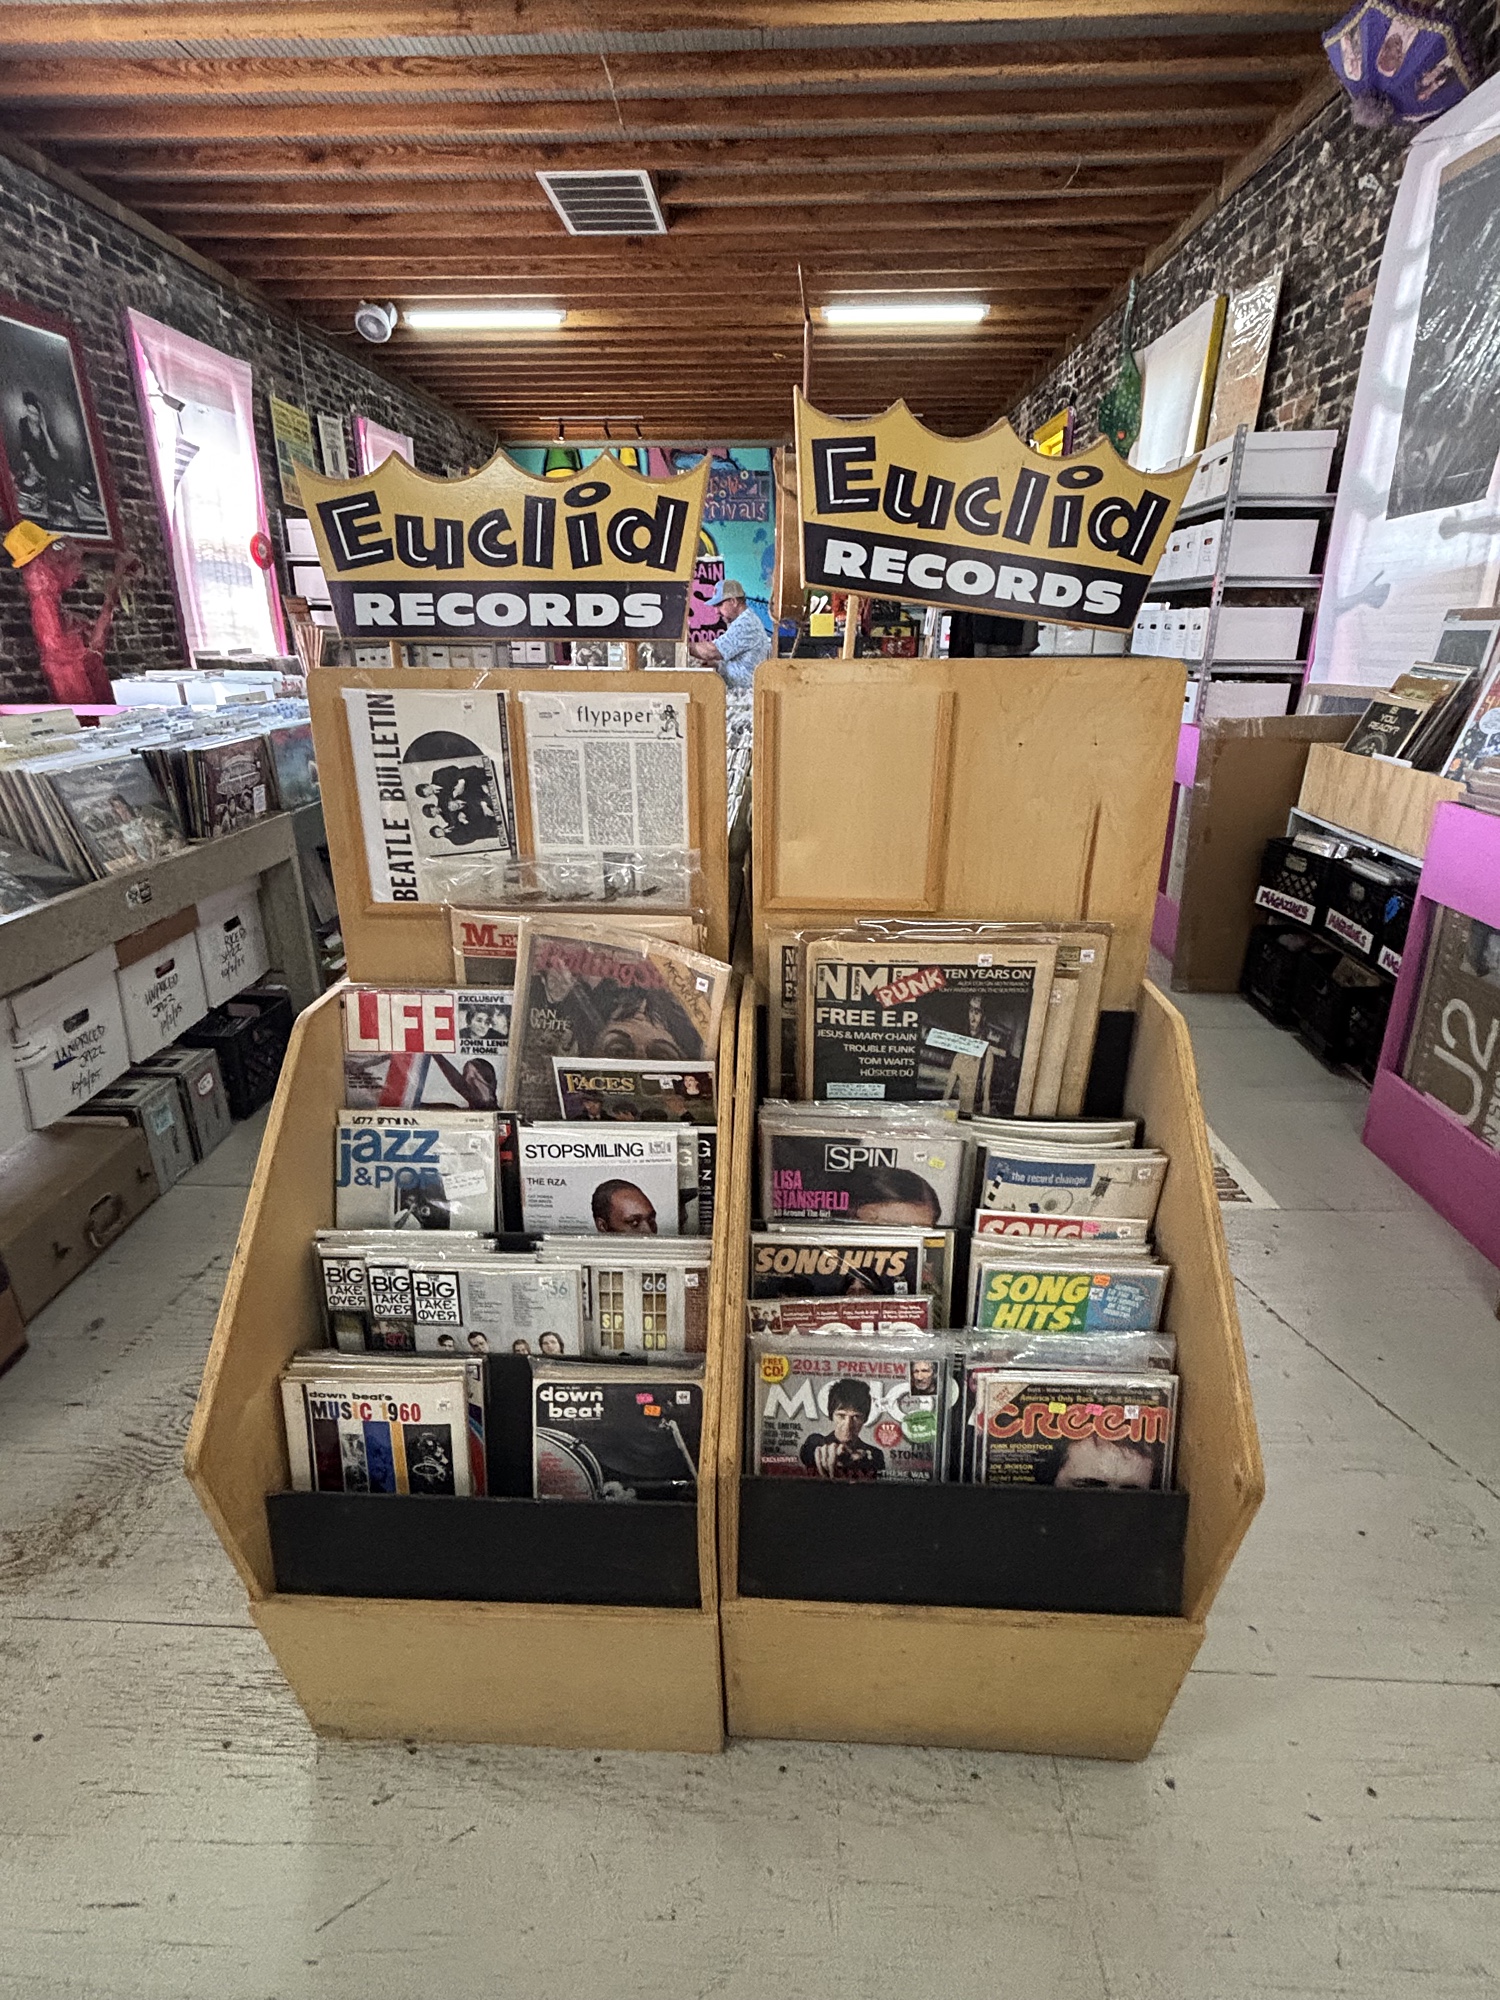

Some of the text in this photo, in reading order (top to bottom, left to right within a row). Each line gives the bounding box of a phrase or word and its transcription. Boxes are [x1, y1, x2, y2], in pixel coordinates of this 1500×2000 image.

[811, 436, 1171, 565] Euclid
[317, 481, 689, 572] Euclid
[823, 539, 1123, 614] RECORDS
[353, 592, 663, 628] RECORDS
[577, 705, 652, 727] flypaper
[1379, 714, 1398, 724] YOU
[1368, 721, 1400, 735] READY?
[366, 694, 418, 901] BEATLE BULLETIN
[943, 968, 1032, 980] TEN YEARS ON
[879, 967, 943, 1006] PUNK
[458, 995, 505, 1003] EXCLUSIVE
[530, 1008, 557, 1019] DAN
[816, 1007, 918, 1027] FREE E.P.
[346, 993, 455, 1051] LIFE
[530, 1018, 571, 1031] WHITE
[460, 1039, 484, 1047] JOHN
[817, 1029, 917, 1041] JESUS & MARY CHAIN
[472, 1047, 498, 1055] HOME
[843, 1043, 916, 1053] TROUBLE FUNK
[858, 1057, 915, 1066] TOM WAITS
[860, 1067, 913, 1077] HÜSKER DÜ
[564, 1074, 635, 1093] FACES
[336, 1128, 440, 1187] jazz
[525, 1142, 644, 1159] STOPSMILING
[829, 1146, 896, 1171] SPIN
[527, 1178, 566, 1186] THE RZA
[773, 1170, 803, 1190] LISA
[1012, 1172, 1088, 1186] the record changer
[772, 1190, 850, 1210] STANSFIELD
[755, 1248, 908, 1277] SONG HITS
[326, 1267, 364, 1283] BIG
[371, 1276, 410, 1292] BIG
[415, 1282, 455, 1298] BIG
[643, 1277, 666, 1291] 66
[986, 1273, 1090, 1303] SONG
[992, 1303, 1076, 1330] HITS
[763, 1358, 783, 1366] FREE
[792, 1359, 907, 1375] 2013 PREVIEW
[763, 1366, 784, 1377] CD!
[309, 1391, 393, 1401] down beat's
[539, 1386, 603, 1402] down
[310, 1400, 421, 1422] MUSIC 1960
[549, 1402, 604, 1418] beat
